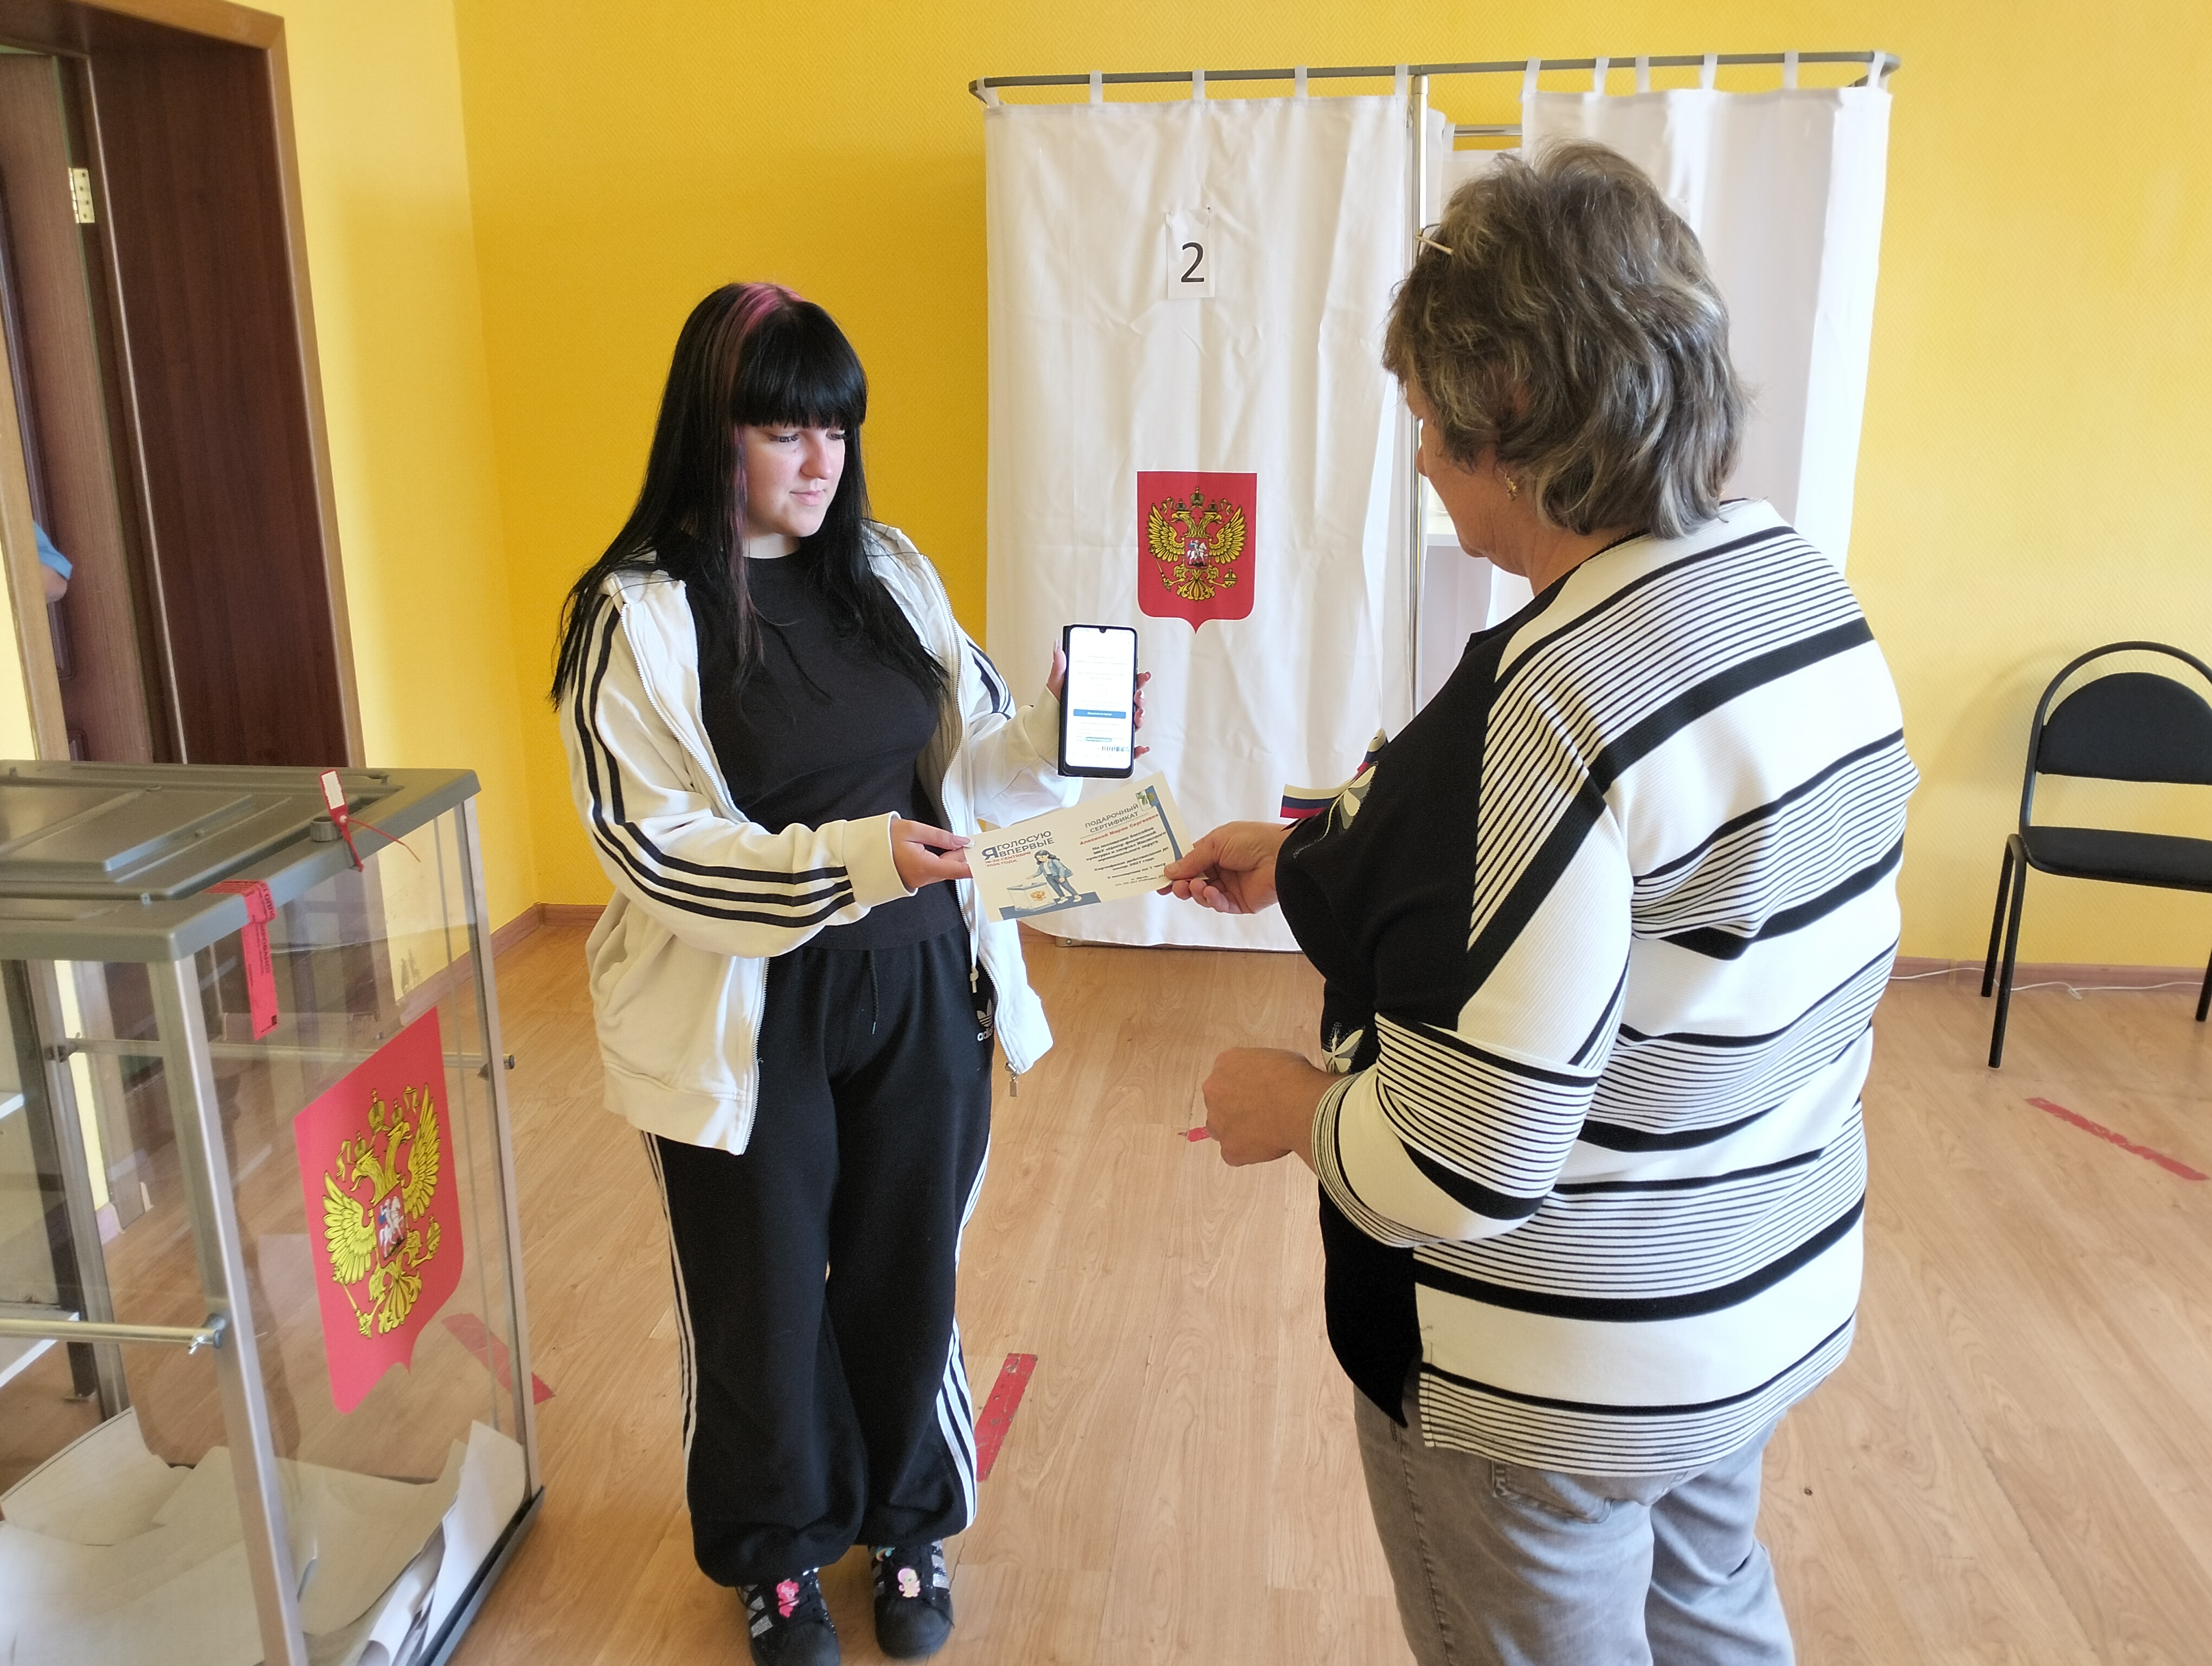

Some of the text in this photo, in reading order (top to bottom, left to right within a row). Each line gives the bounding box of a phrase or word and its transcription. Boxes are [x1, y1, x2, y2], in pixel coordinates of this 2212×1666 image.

[1181, 242, 1205, 283] 2
[1084, 803, 1139, 828] ПОДАРОЧНЫЙ
[1090, 811, 1139, 833] СЕРТИФИКАТ
[981, 830, 1051, 860] Я ГОЛОСУЮ
[999, 837, 1054, 857] ВПЕРВЫЕ
[1000, 851, 1031, 861] СЕНТЯБРЯ
